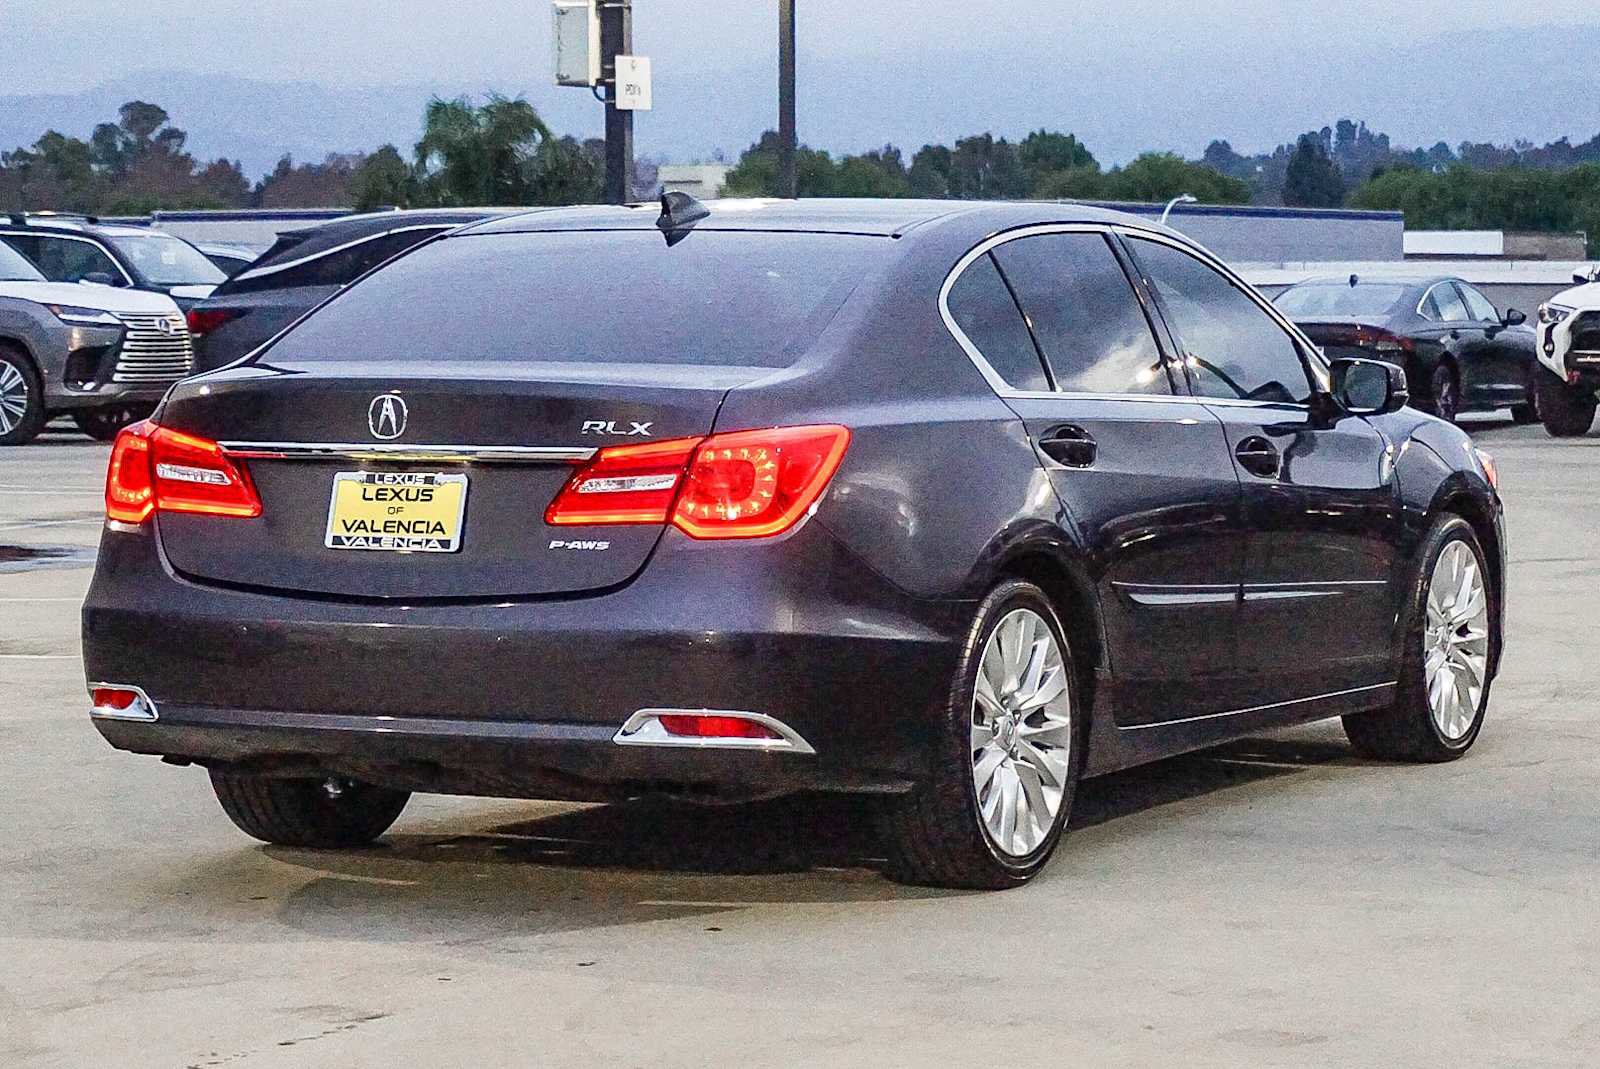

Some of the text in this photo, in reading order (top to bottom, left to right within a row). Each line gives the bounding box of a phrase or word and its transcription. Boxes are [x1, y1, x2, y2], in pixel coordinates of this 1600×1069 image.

[581, 420, 654, 436] RLX
[375, 474, 425, 485] LEXUS
[362, 487, 434, 502] LEXUS
[387, 506, 405, 515] OF
[342, 519, 446, 535] VALENCIA
[341, 536, 443, 549] VALENCIA
